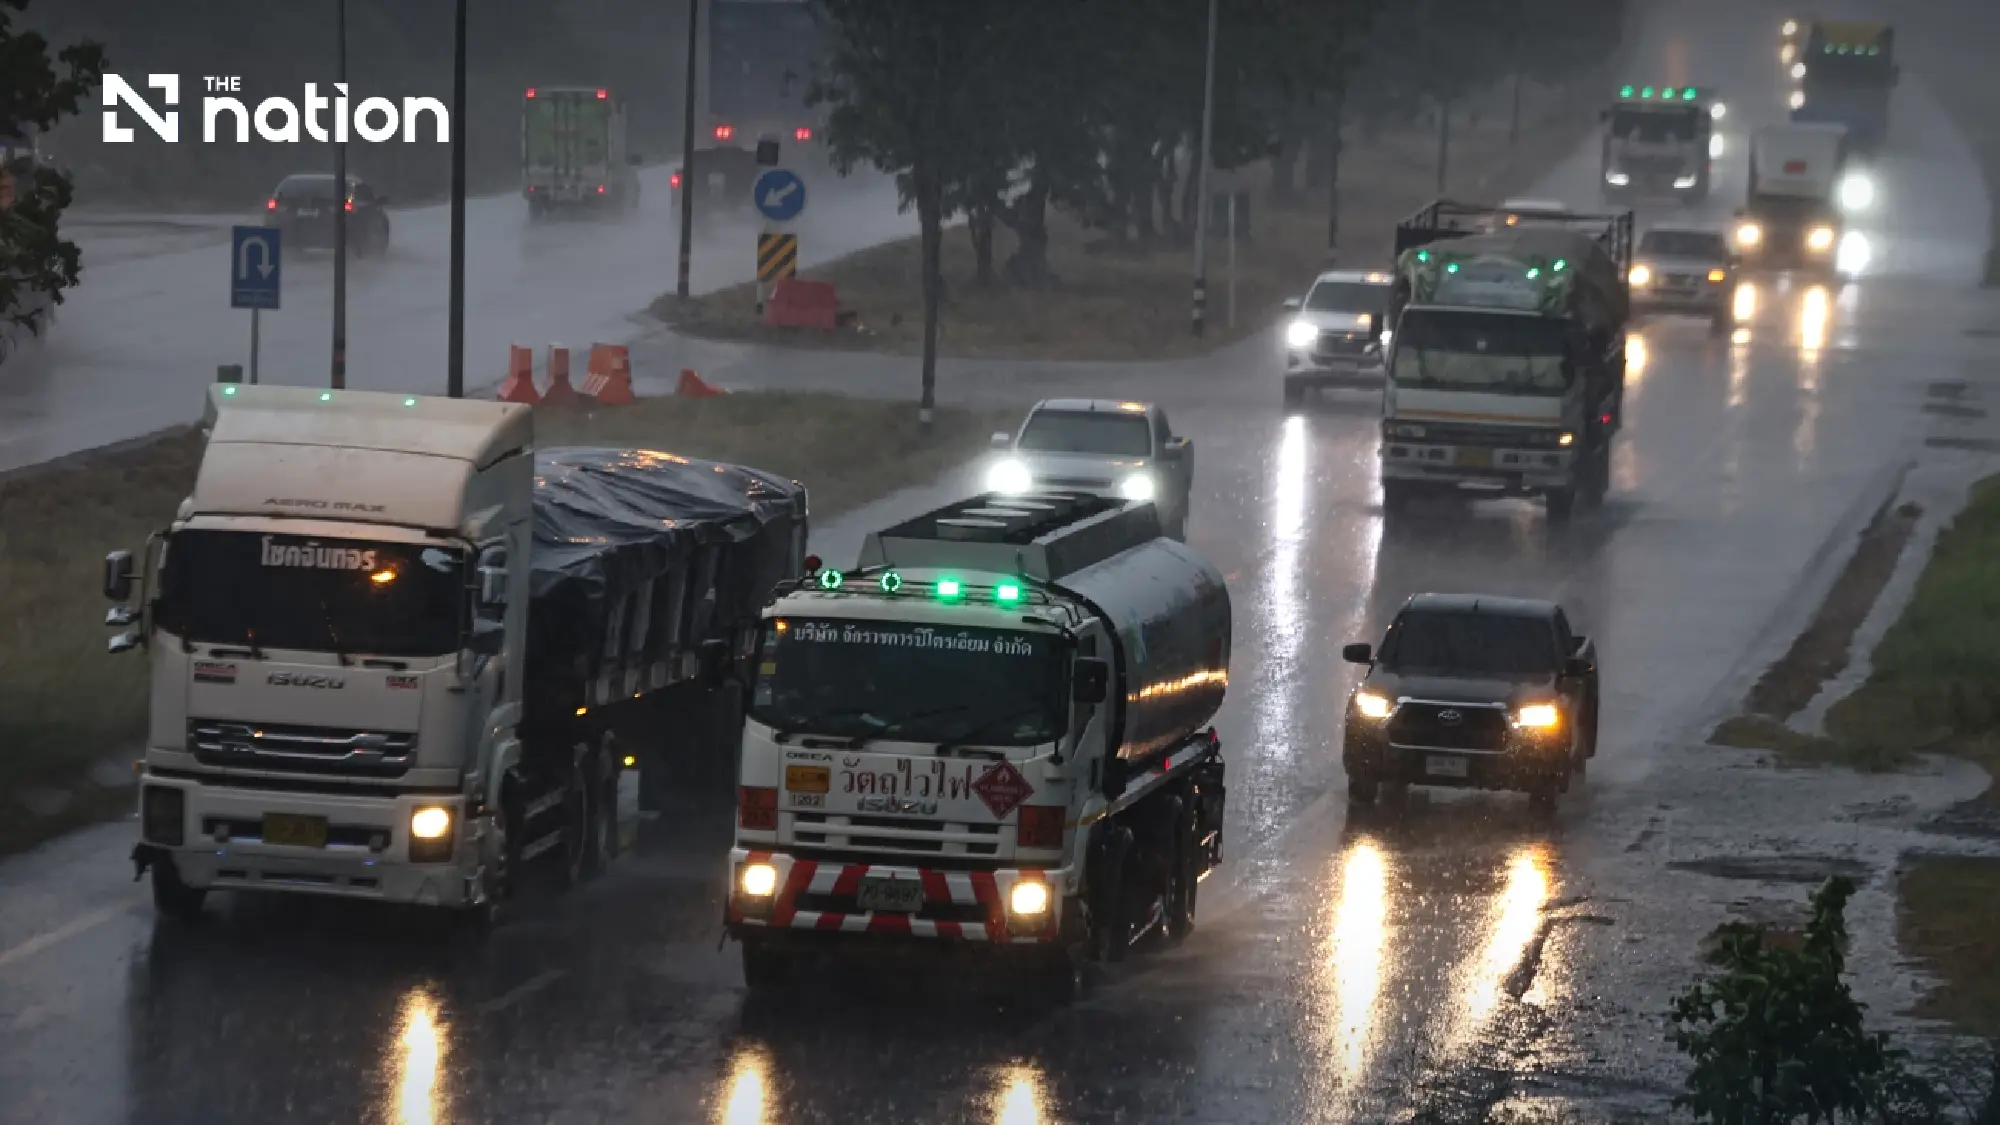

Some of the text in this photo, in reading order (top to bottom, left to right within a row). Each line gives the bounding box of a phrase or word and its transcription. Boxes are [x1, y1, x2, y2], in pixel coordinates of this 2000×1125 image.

[794, 622, 838, 643] บริษัท
[994, 635, 1033, 656] จำกัด
[267, 672, 344, 689] ISUZU
[841, 757, 973, 805] วัตถุไวไฟ
[857, 796, 938, 814] ISUZU
